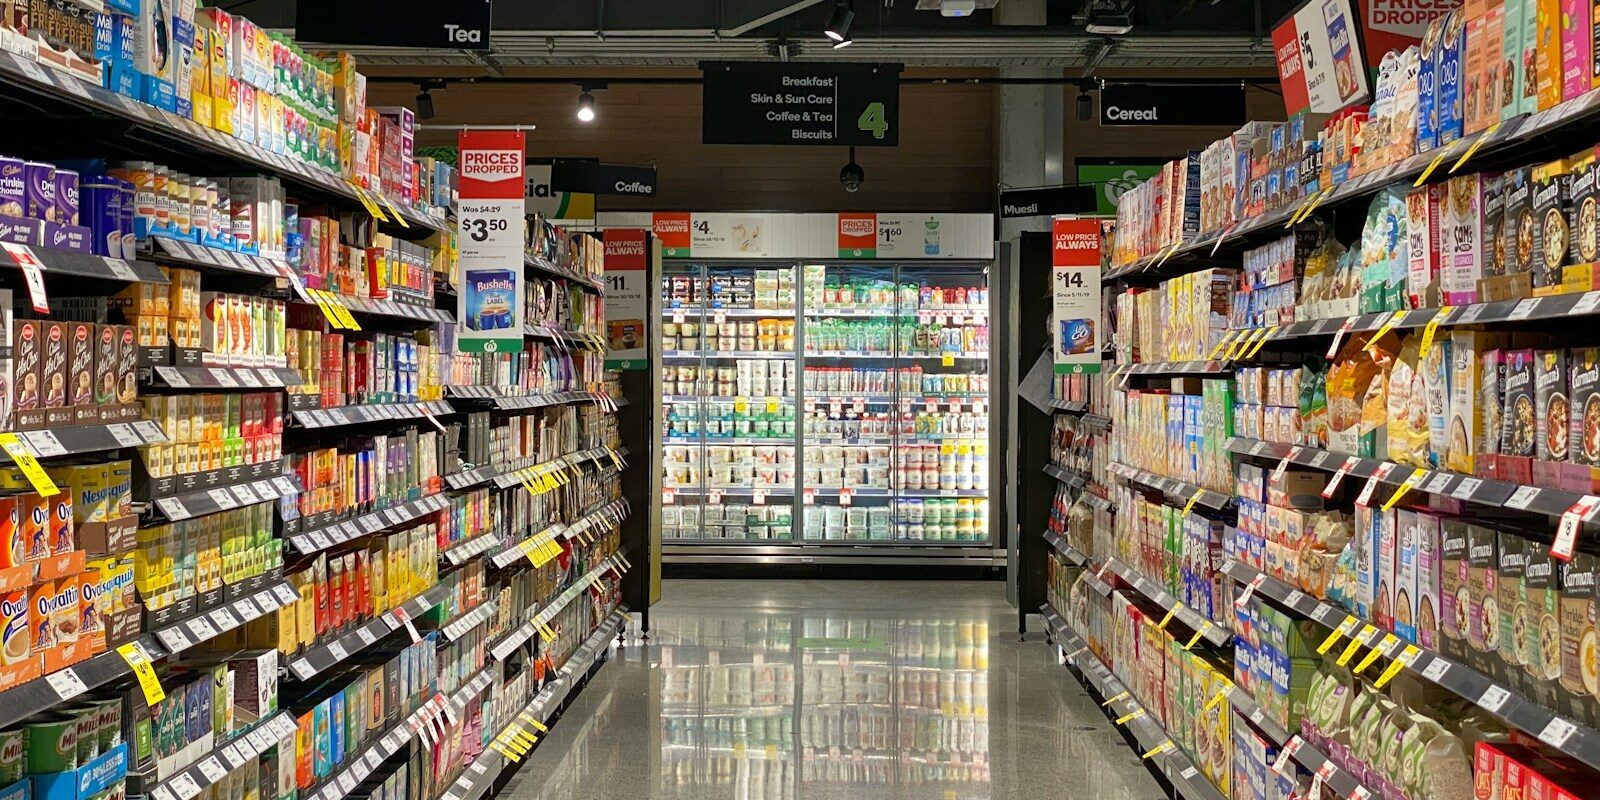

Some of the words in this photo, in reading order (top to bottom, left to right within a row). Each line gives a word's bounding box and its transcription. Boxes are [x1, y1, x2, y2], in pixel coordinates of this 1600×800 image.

[444, 24, 481, 43] Tea
[782, 76, 833, 86] Breakfast
[751, 93, 773, 103] Skin
[774, 94, 783, 104] &
[785, 94, 805, 104] Sun
[807, 94, 833, 104] Care
[766, 111, 800, 121] Coffee
[802, 112, 811, 121] &
[812, 112, 833, 121] Tea
[1107, 106, 1158, 120] Cereal
[858, 102, 889, 139] 4
[792, 129, 832, 139] Biscuits
[465, 153, 519, 164] PRICES
[465, 165, 518, 173] DROPPED
[615, 181, 652, 193] Coffee
[1004, 203, 1038, 214] Muesli
[655, 225, 688, 233] ALWAYS
[693, 220, 710, 235] $4
[1074, 233, 1098, 241] PRICE
[605, 246, 644, 255] ALWAYS
[1056, 240, 1099, 250] ALWAYS
[606, 276, 625, 290] $11
[1056, 271, 1083, 288] $14
[477, 279, 513, 292] Bushells
[1476, 770, 1490, 790] OATS
